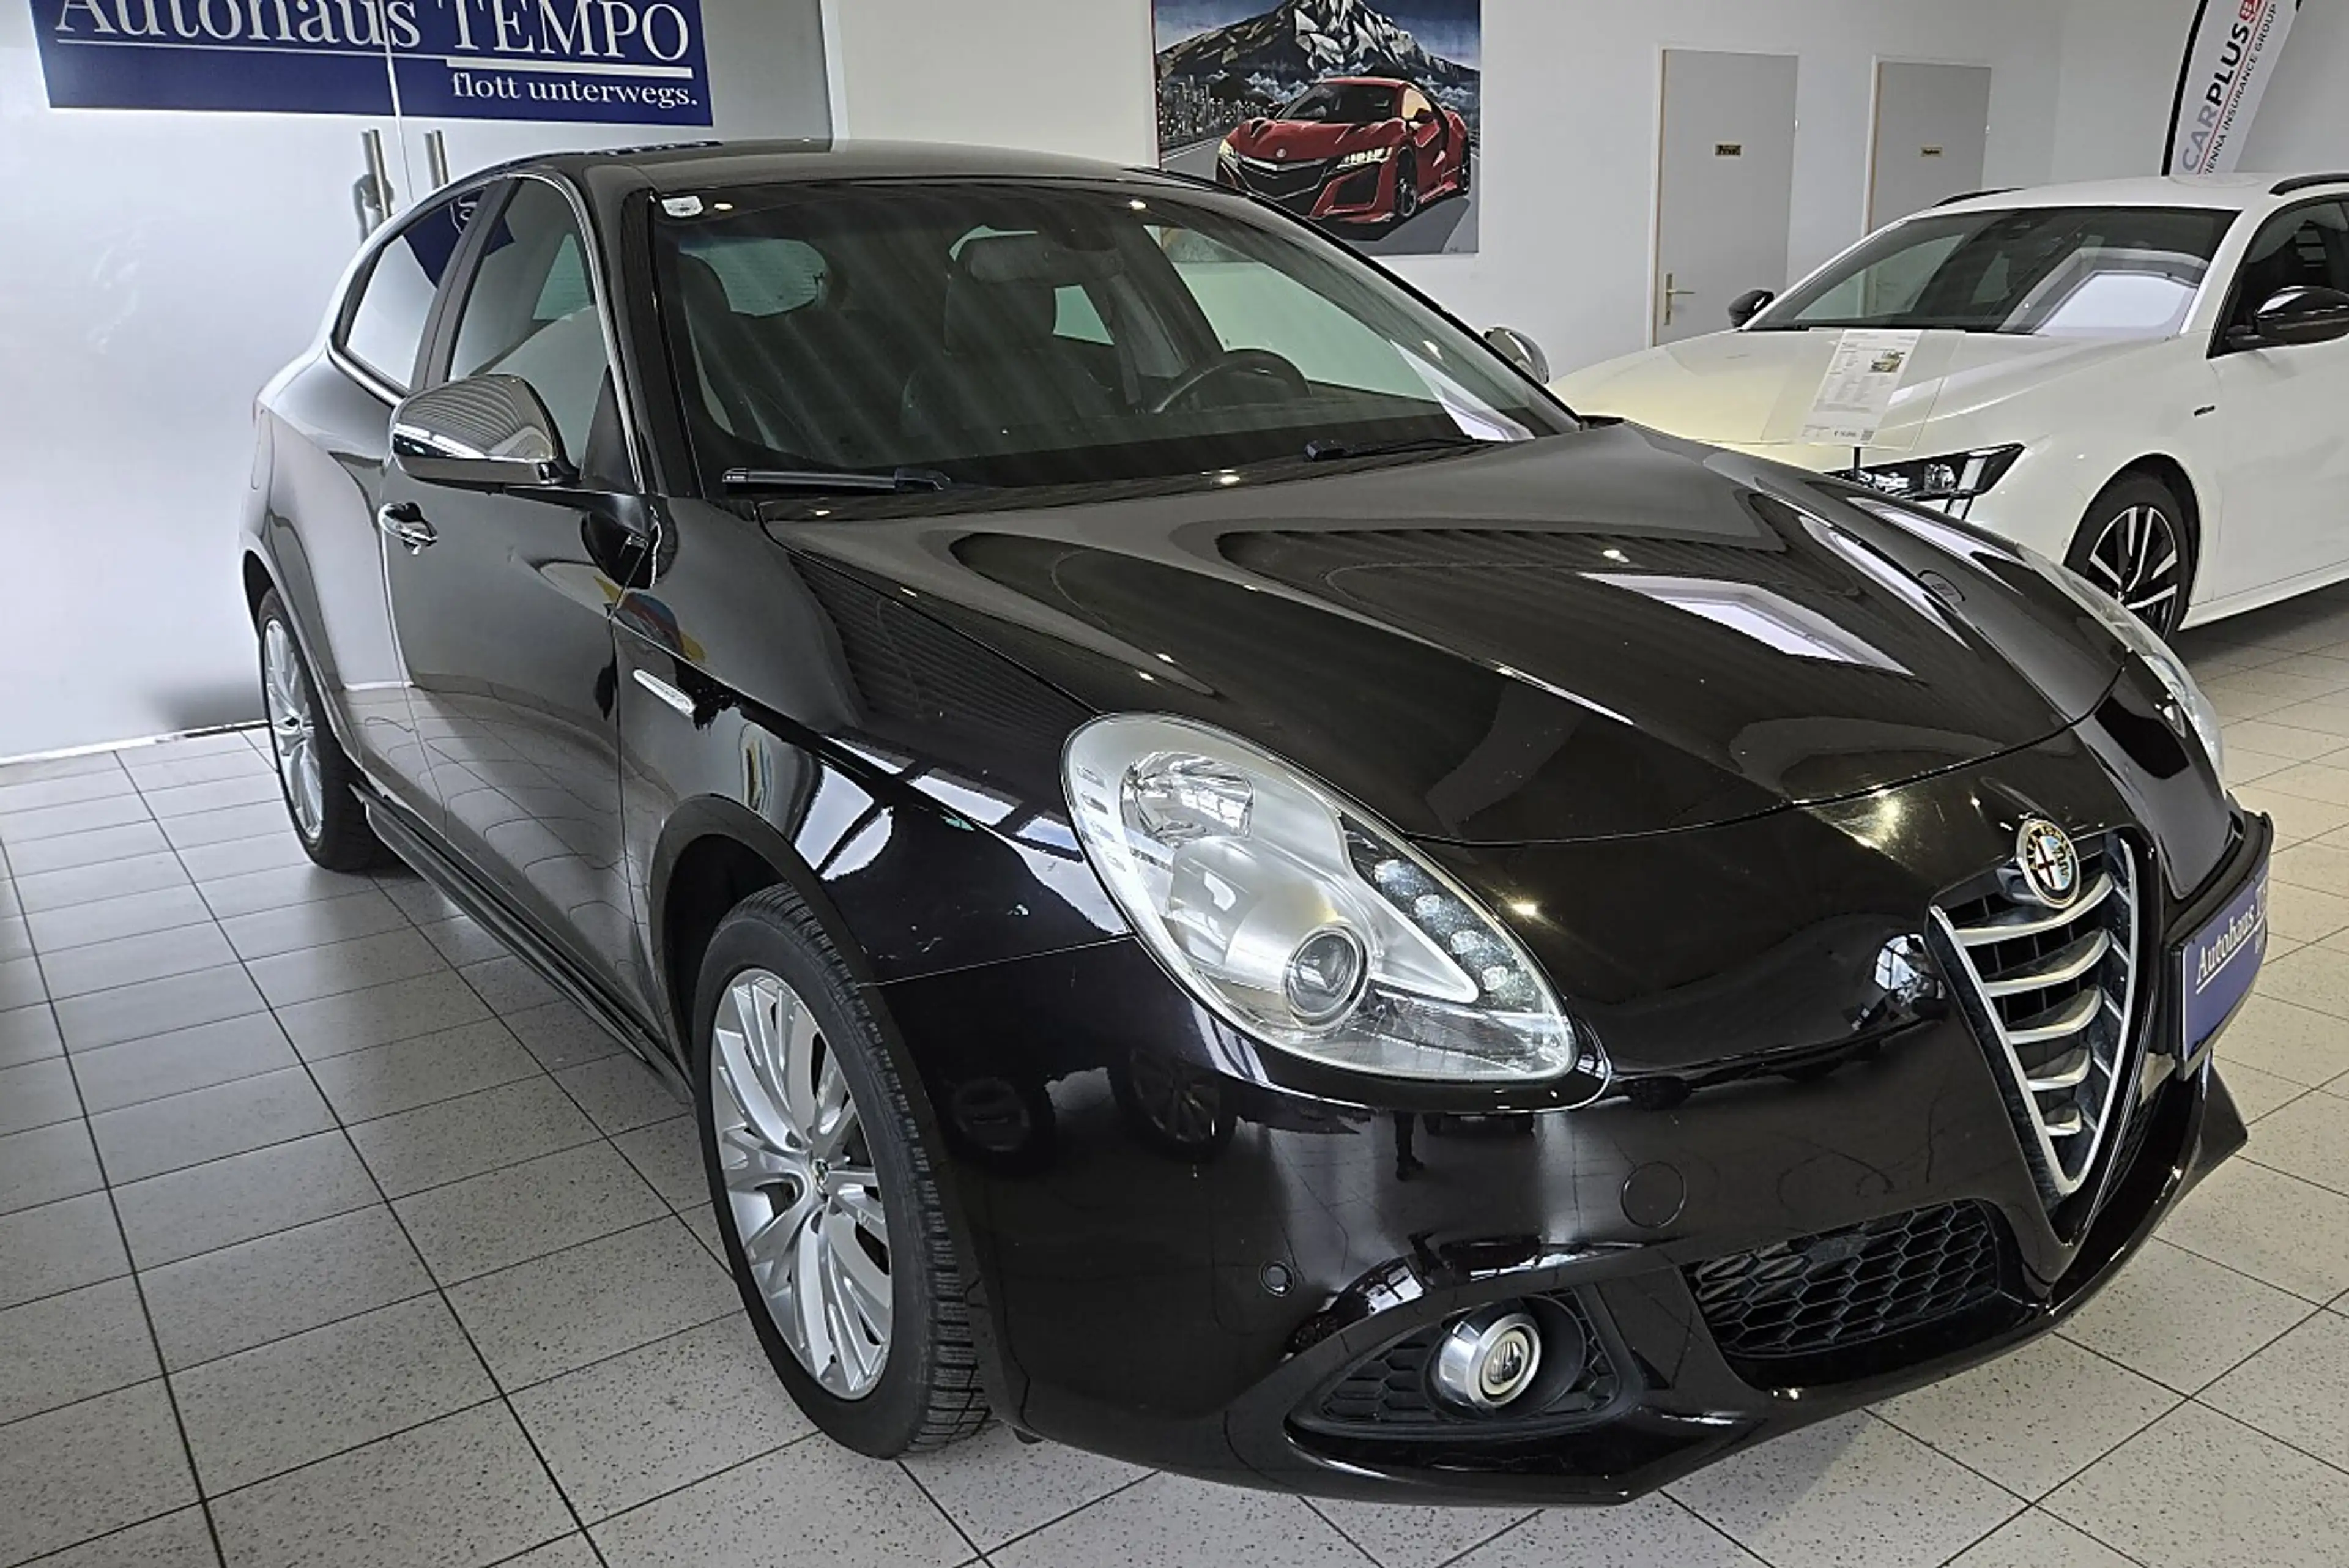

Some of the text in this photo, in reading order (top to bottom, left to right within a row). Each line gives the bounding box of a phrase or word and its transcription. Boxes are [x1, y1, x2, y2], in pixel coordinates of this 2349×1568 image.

[55, 0, 692, 61] Autohaus TEMPO
[451, 72, 698, 109] flott unterwegs.
[2182, 23, 2250, 171] CARPLUS
[2204, 4, 2276, 175] IENNA INSURANCE GROUP
[2196, 904, 2254, 986] Autohaus
